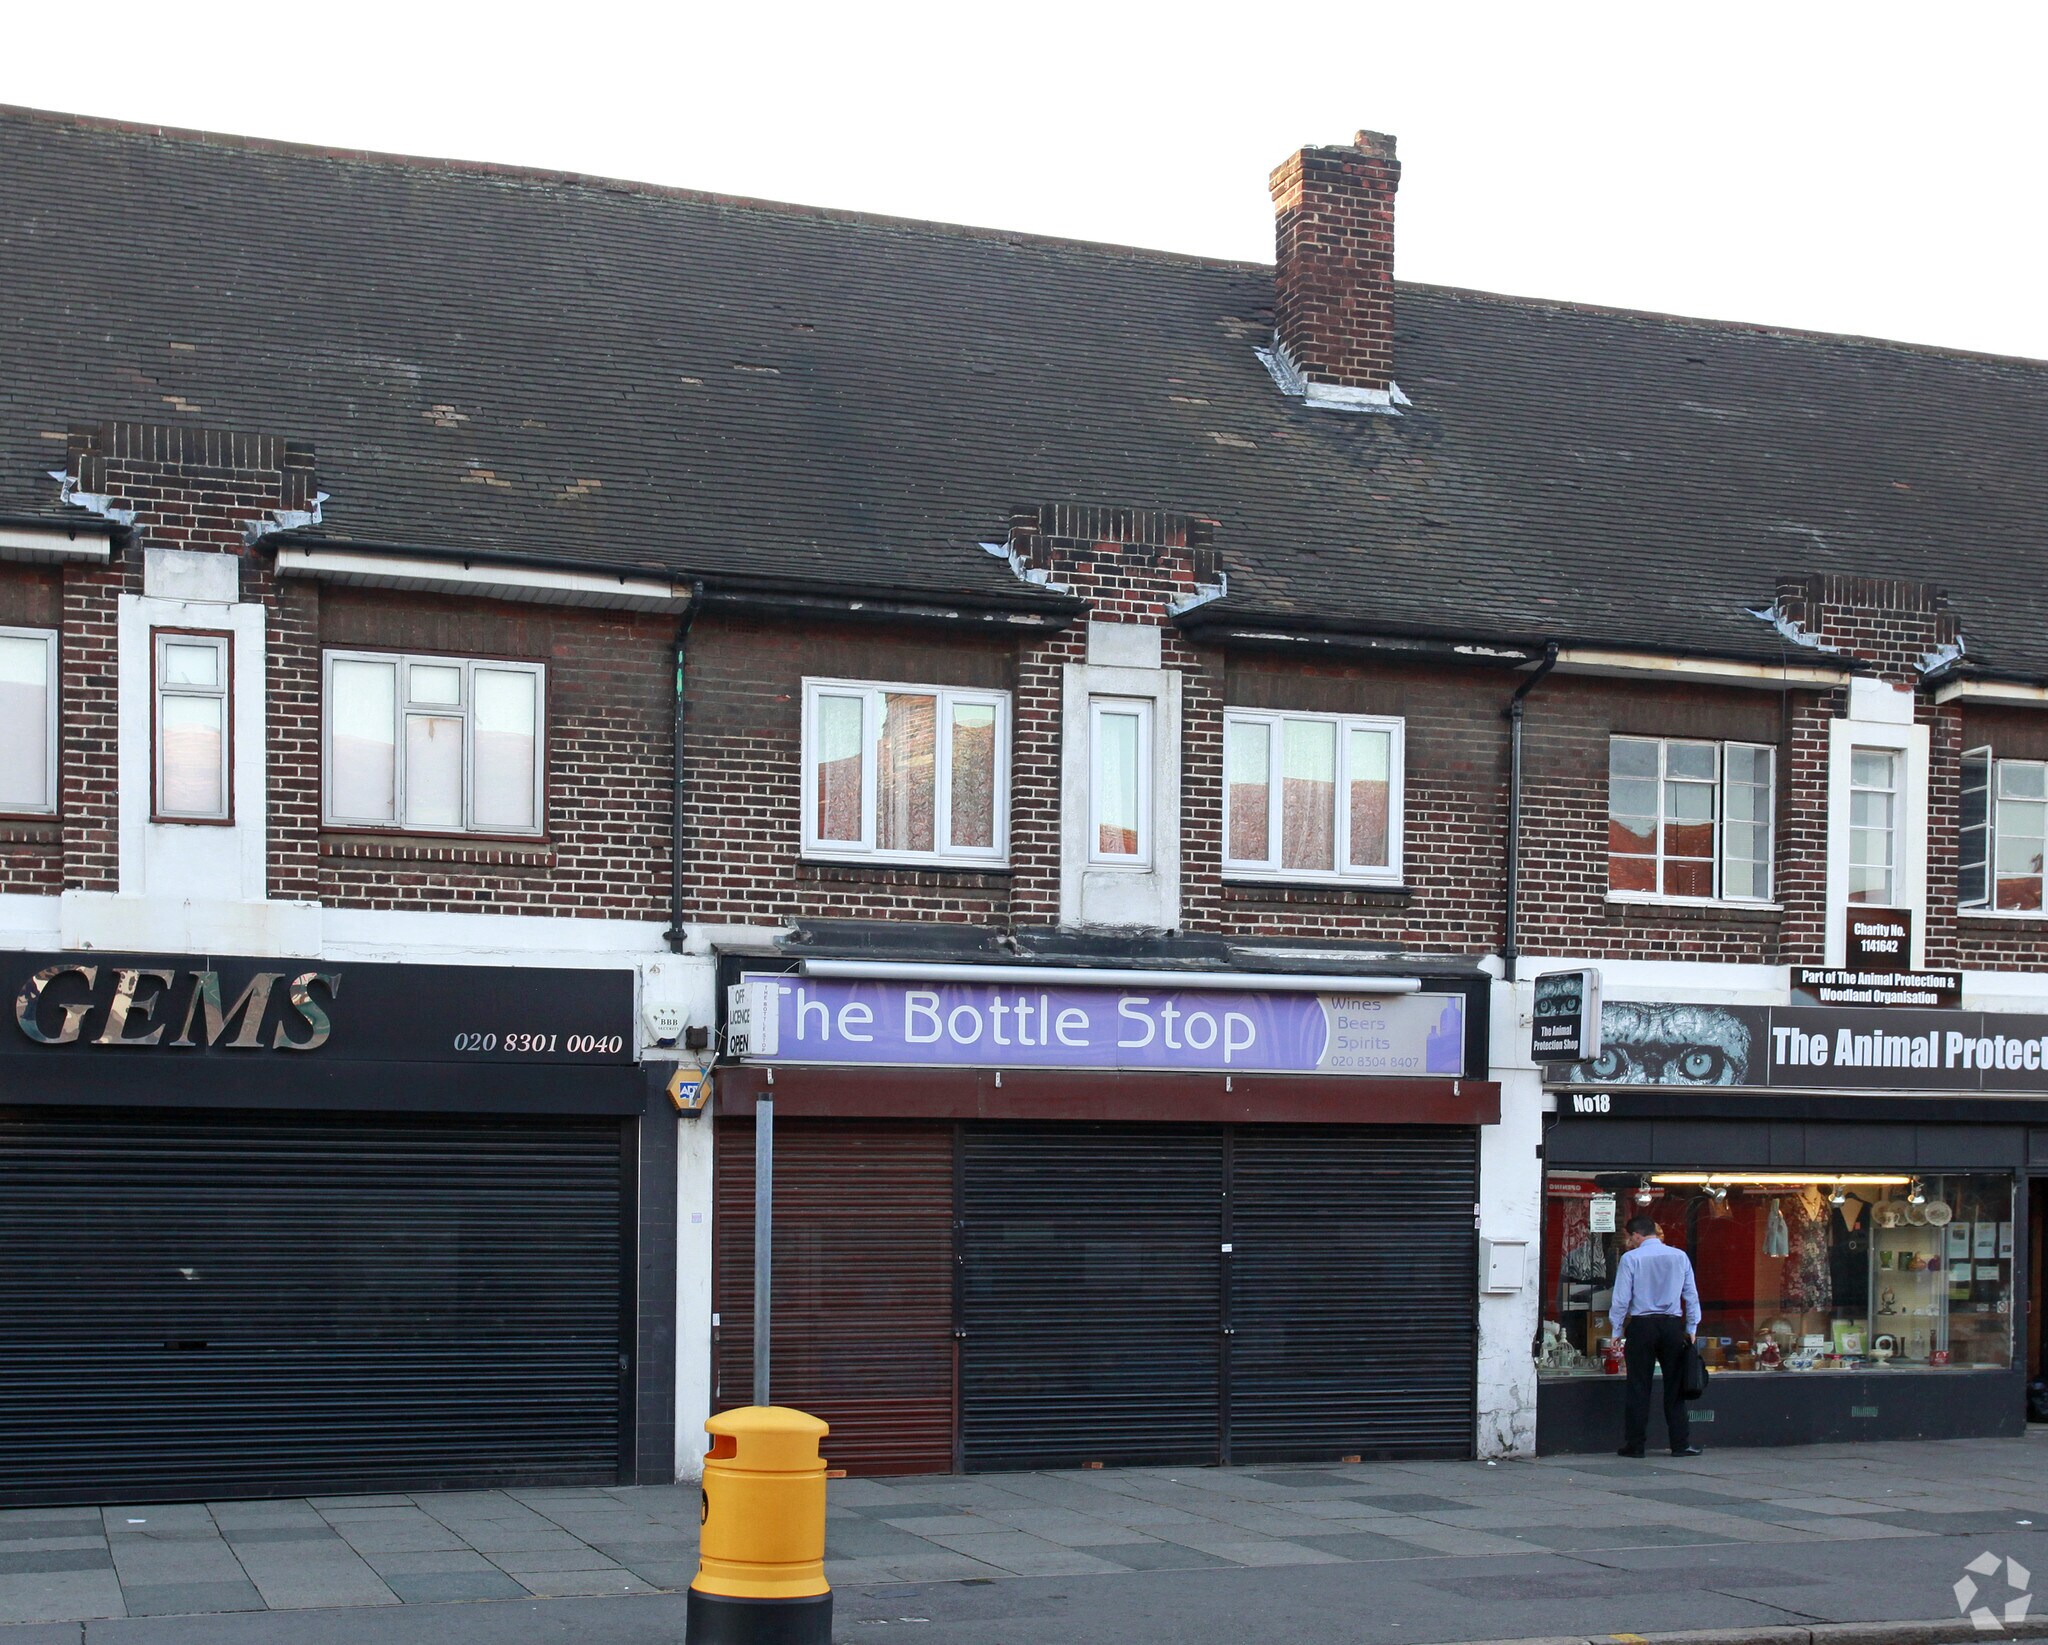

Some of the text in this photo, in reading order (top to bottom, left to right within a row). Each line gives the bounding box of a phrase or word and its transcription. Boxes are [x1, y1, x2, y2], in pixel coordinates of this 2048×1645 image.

[1853, 922, 1905, 937] Charity No.
[1860, 940, 1898, 953] 1141642
[1802, 970, 1955, 988] Part of The Animal Protection &
[735, 989, 745, 1004] OFF
[1820, 987, 1938, 1004] Woodland Organisation
[16, 964, 342, 1050] GEMS
[1331, 997, 1381, 1011] Wines
[730, 1009, 750, 1024] LICENCE
[1338, 1016, 1386, 1030] Beers
[904, 990, 1090, 1047] Bottle
[1117, 997, 1257, 1064] Stop
[1541, 1024, 1572, 1037] The Animal
[453, 1033, 623, 1054] 020 8301 0040
[729, 1034, 749, 1053] OPEN
[1337, 1036, 1390, 1051] Spirits
[1533, 1038, 1578, 1051] Protection Shop
[1772, 1027, 2048, 1071] The Animal Protect
[1331, 1056, 1419, 1068] 020 8304 8407
[1573, 1094, 1611, 1113] No18
